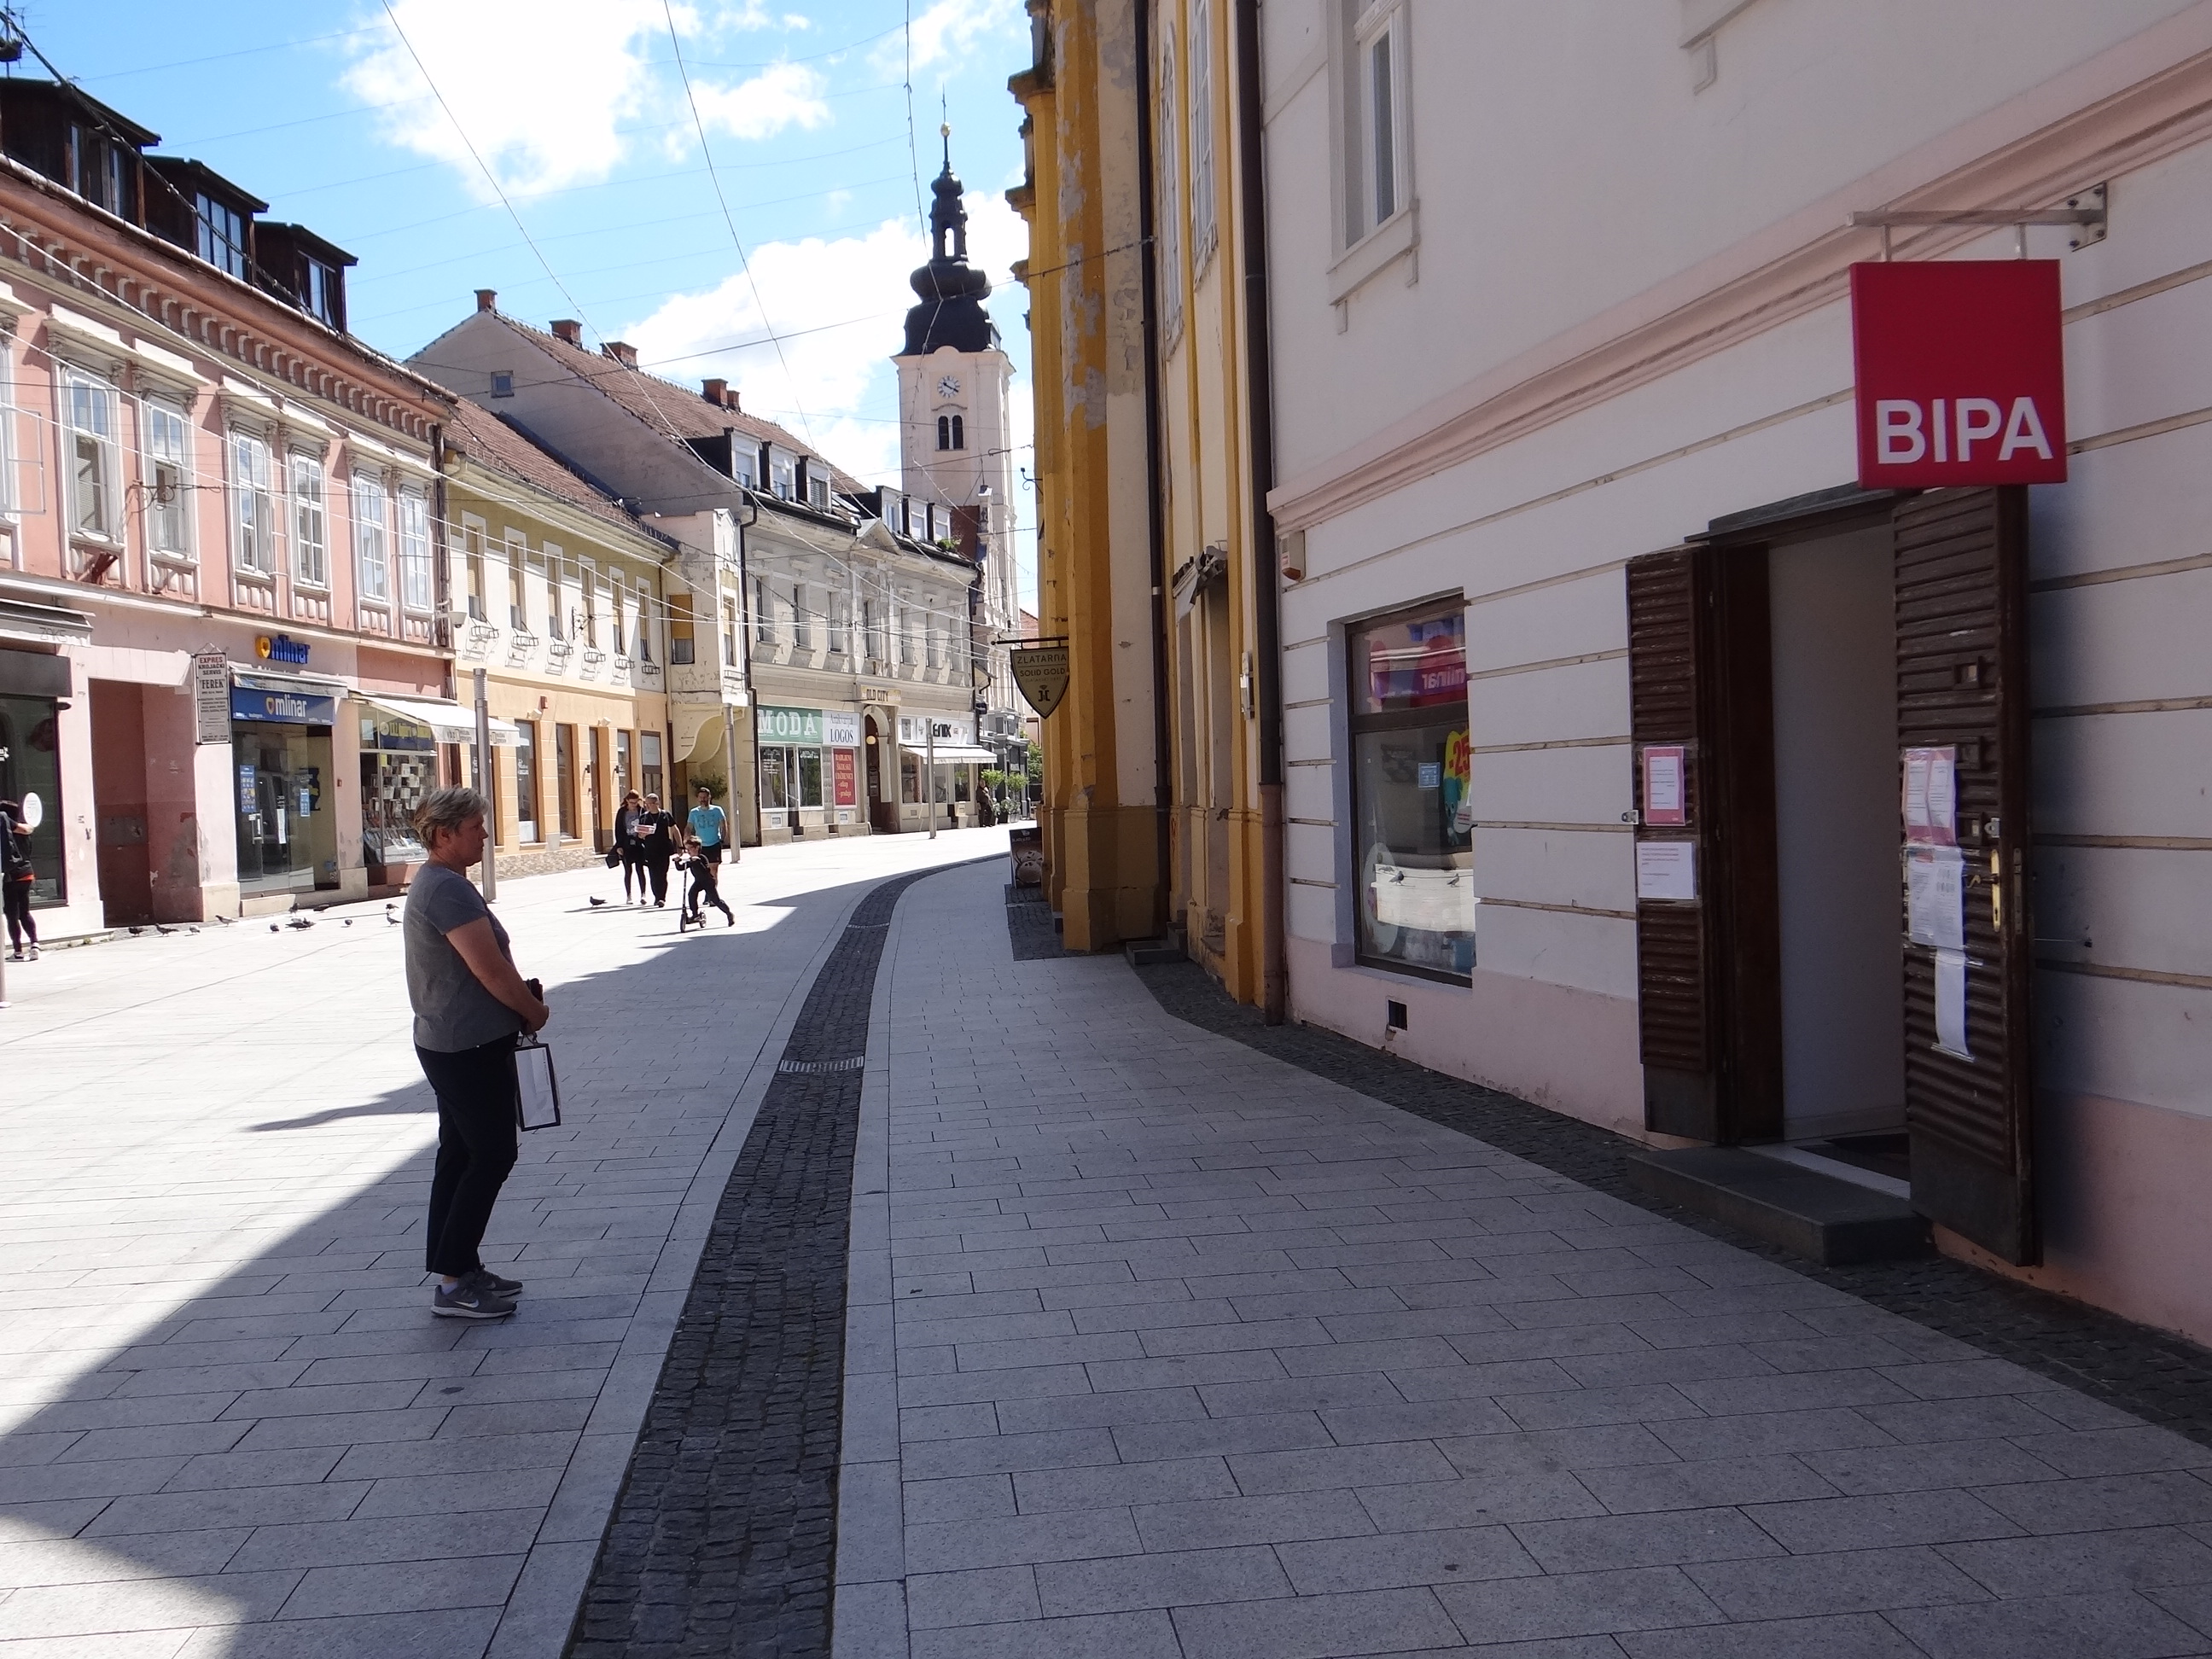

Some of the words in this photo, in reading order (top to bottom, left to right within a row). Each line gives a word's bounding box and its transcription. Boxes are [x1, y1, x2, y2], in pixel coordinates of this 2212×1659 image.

[1876, 396, 2052, 464] BIPA
[271, 635, 311, 664] mlinar
[1017, 654, 1067, 664] ZLATARNA
[275, 694, 307, 717] mlinar
[866, 688, 876, 701] OLD
[877, 690, 889, 702] CITY
[758, 709, 818, 736] MODA
[830, 728, 853, 743] LOGOS
